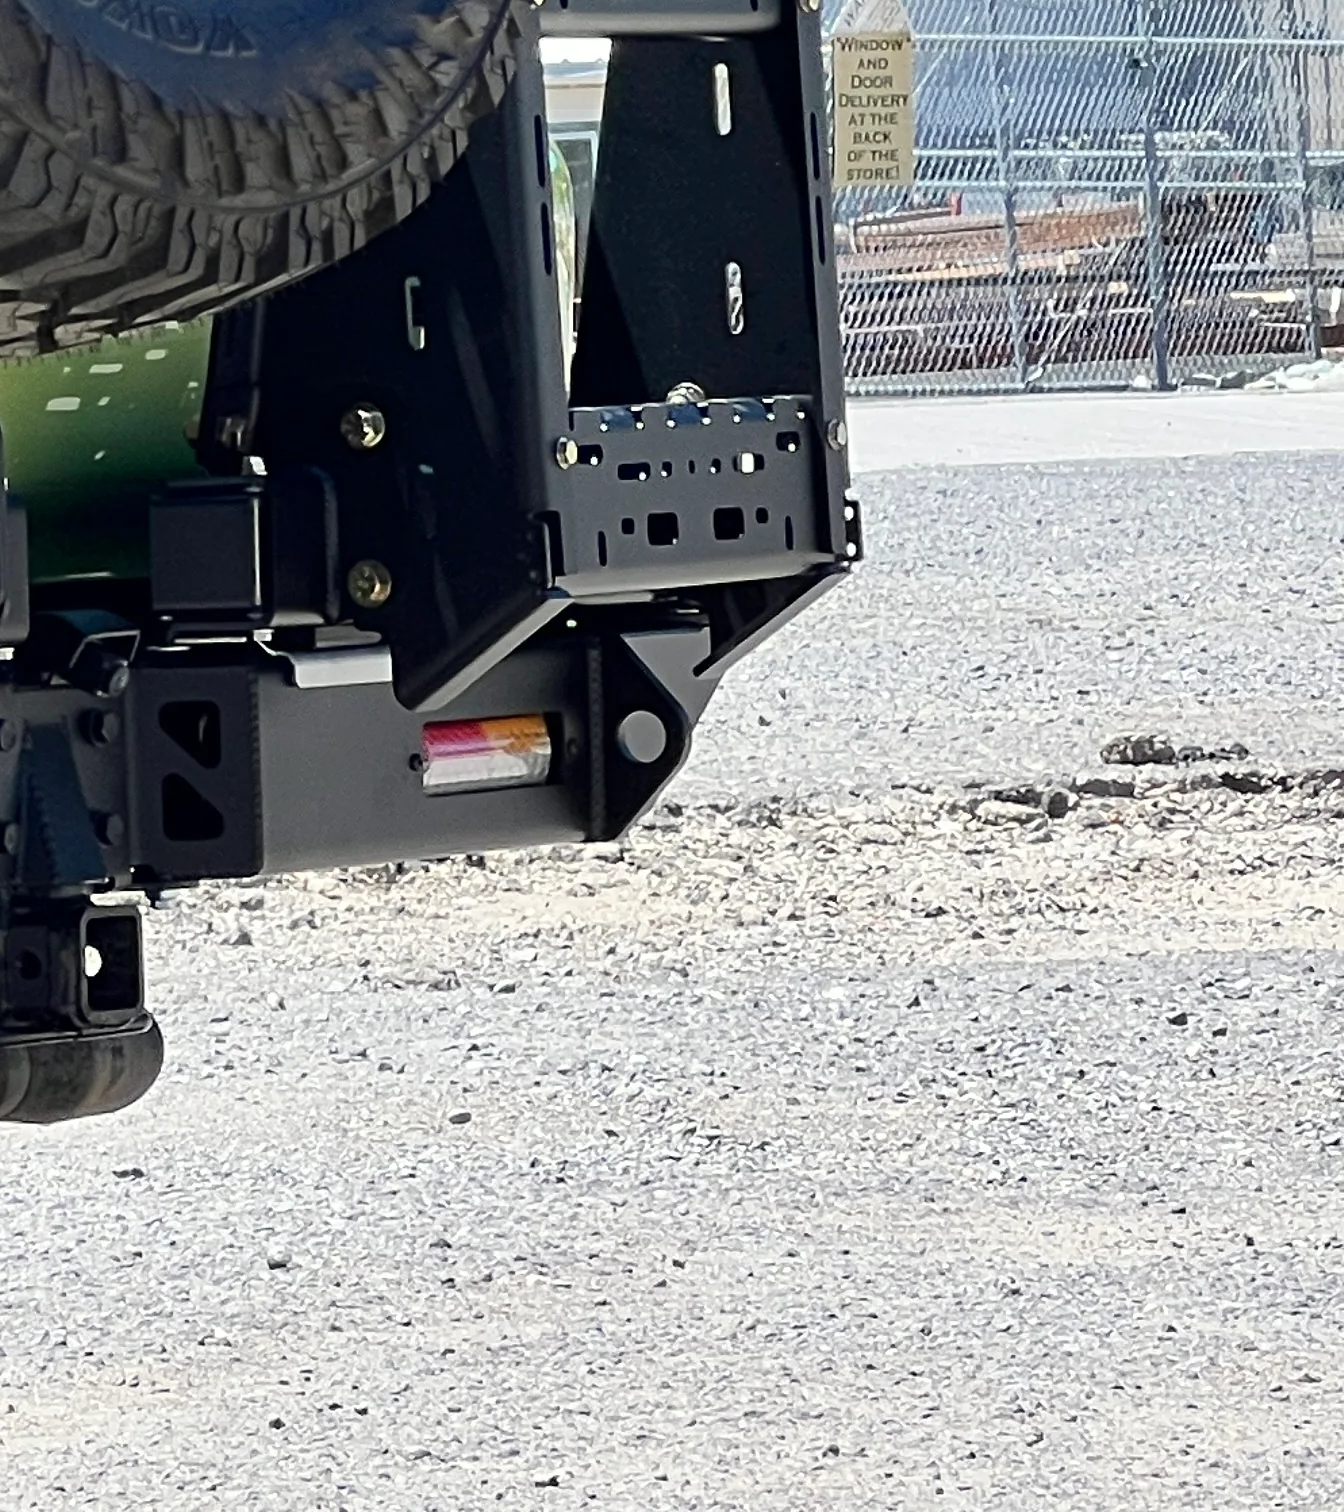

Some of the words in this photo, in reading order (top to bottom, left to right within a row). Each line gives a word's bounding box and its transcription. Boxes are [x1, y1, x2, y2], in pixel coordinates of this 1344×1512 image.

[837, 38, 904, 52] WINDOW
[858, 57, 889, 70] AND
[851, 74, 893, 89] DOOR
[839, 94, 909, 108] DELIVERY
[848, 113, 866, 126] AT
[869, 112, 899, 125] THE
[852, 131, 893, 145] BACK
[847, 150, 866, 162] OF
[869, 149, 900, 162] THE
